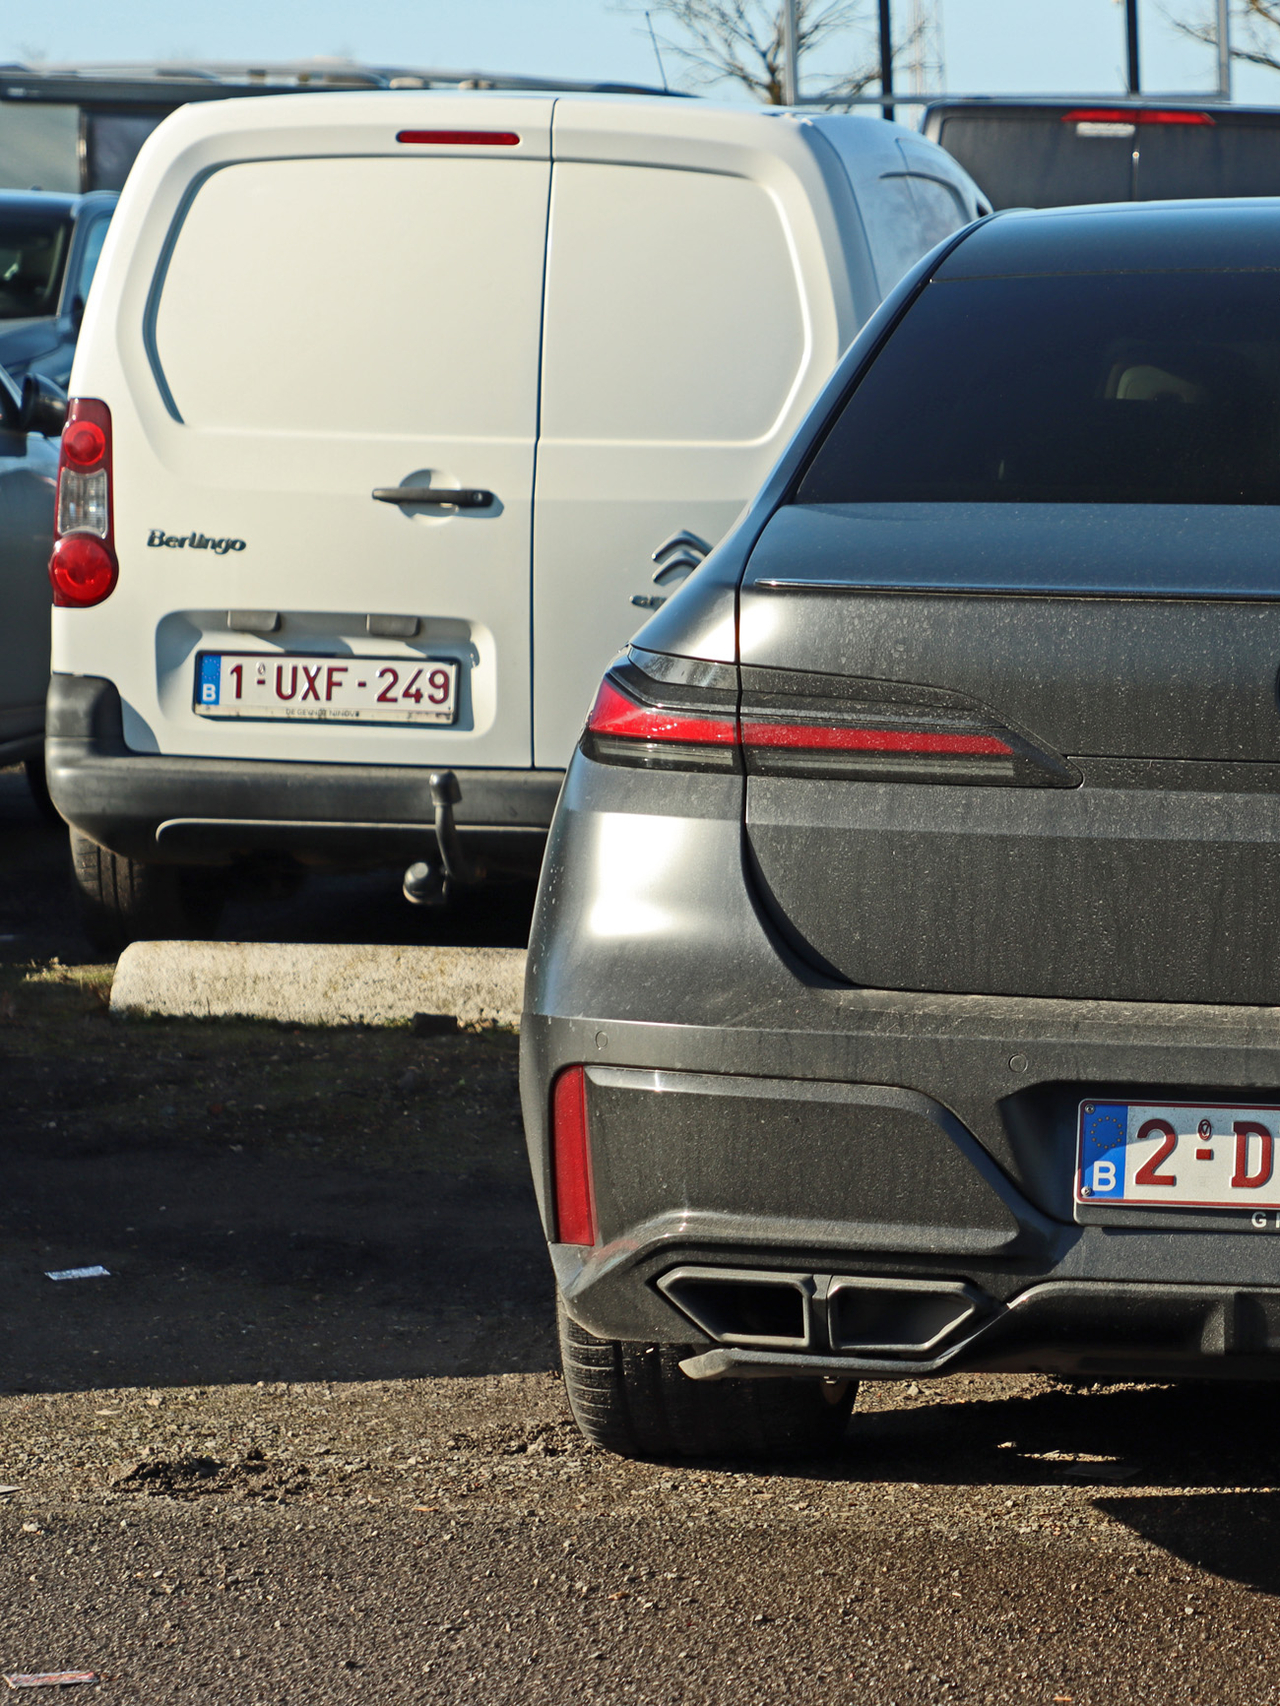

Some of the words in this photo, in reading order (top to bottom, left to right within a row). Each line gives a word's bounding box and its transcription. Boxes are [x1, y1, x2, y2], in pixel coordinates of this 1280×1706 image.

[147, 529, 247, 555] Berlingo
[202, 683, 217, 701] B
[230, 664, 450, 705] 1-UXF-249
[1093, 1161, 1117, 1192] B
